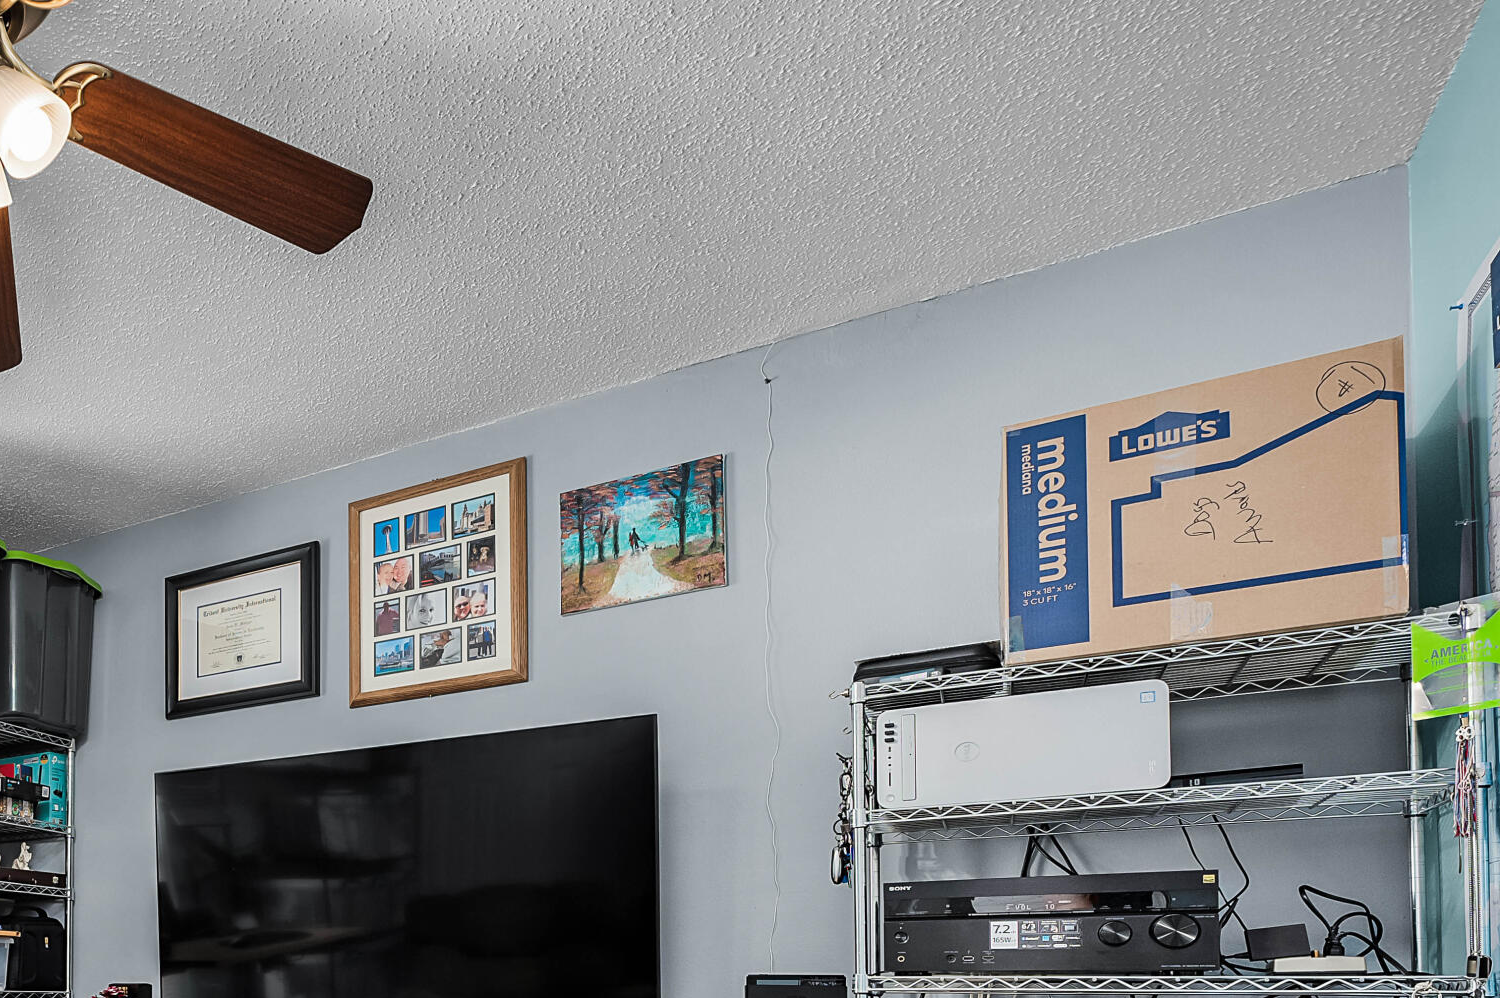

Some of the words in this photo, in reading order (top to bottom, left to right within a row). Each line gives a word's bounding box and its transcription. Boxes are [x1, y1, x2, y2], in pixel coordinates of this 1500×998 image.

[1121, 419, 1218, 455] LOWE'S
[1021, 443, 1035, 495] mediana
[1037, 436, 1078, 583] medium
[1022, 599, 1029, 607] 3
[1030, 597, 1045, 605] CU
[1046, 594, 1059, 603] FT
